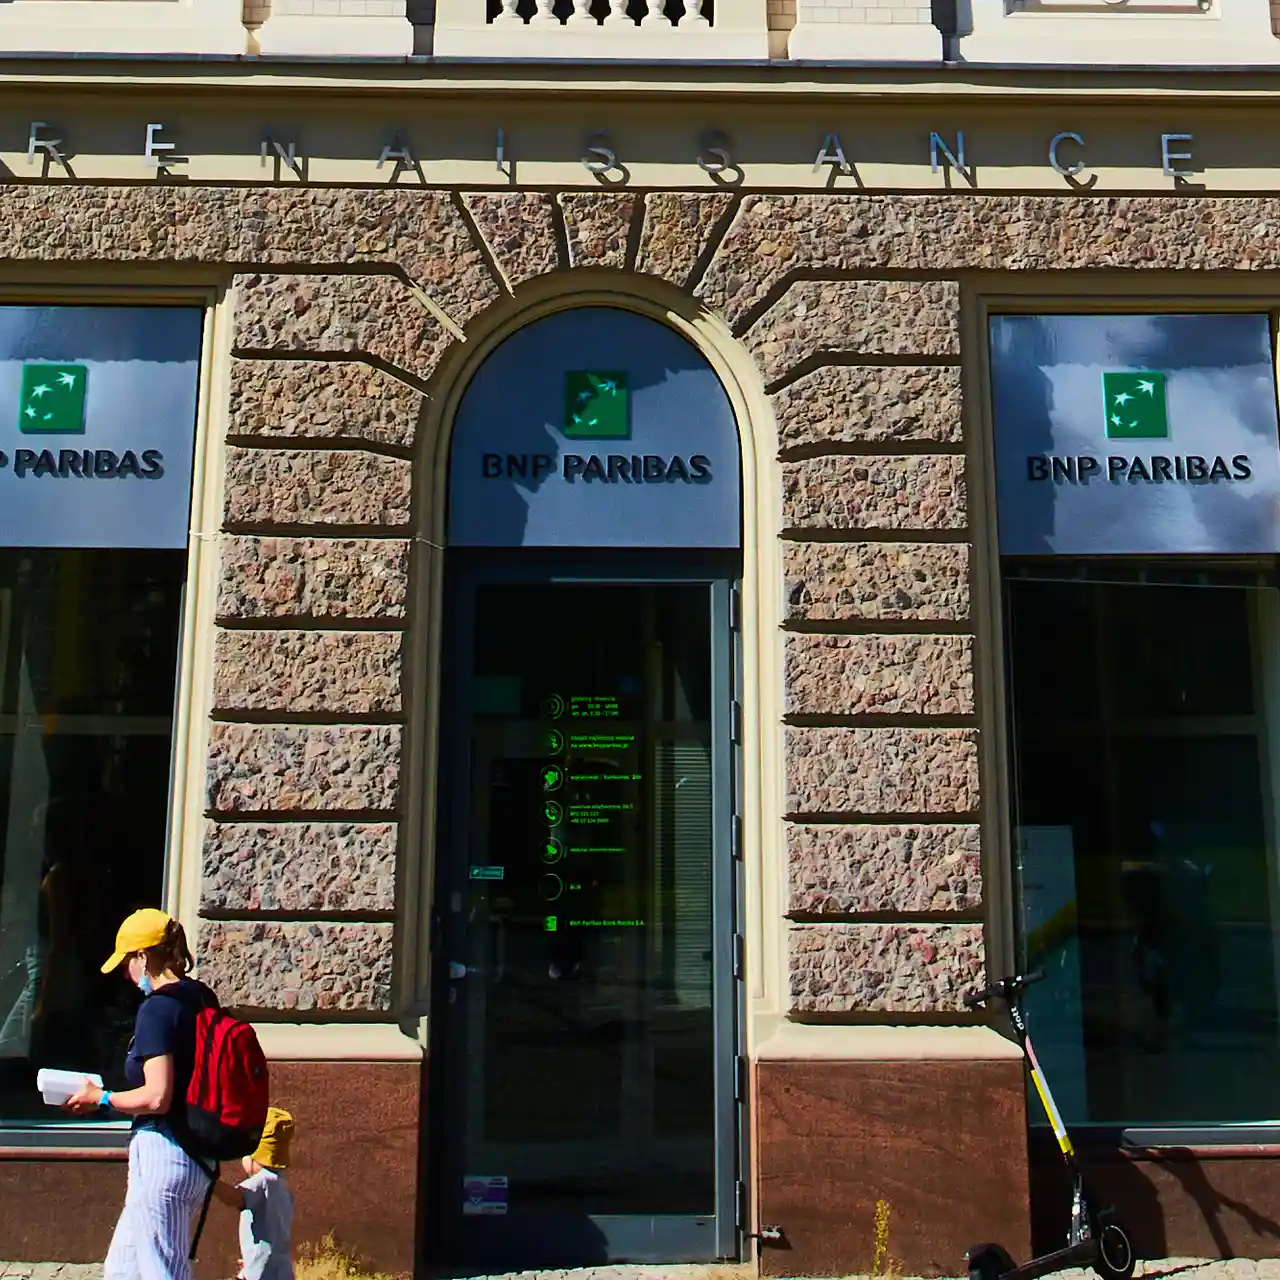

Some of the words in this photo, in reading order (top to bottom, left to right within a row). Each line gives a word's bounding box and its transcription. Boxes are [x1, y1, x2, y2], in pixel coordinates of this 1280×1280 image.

[14, 448, 165, 477] PARIBAS
[482, 453, 554, 479] BNP
[562, 454, 713, 482] PARIBAS
[1027, 455, 1099, 483] BNP
[1106, 454, 1252, 482] PARIBAS
